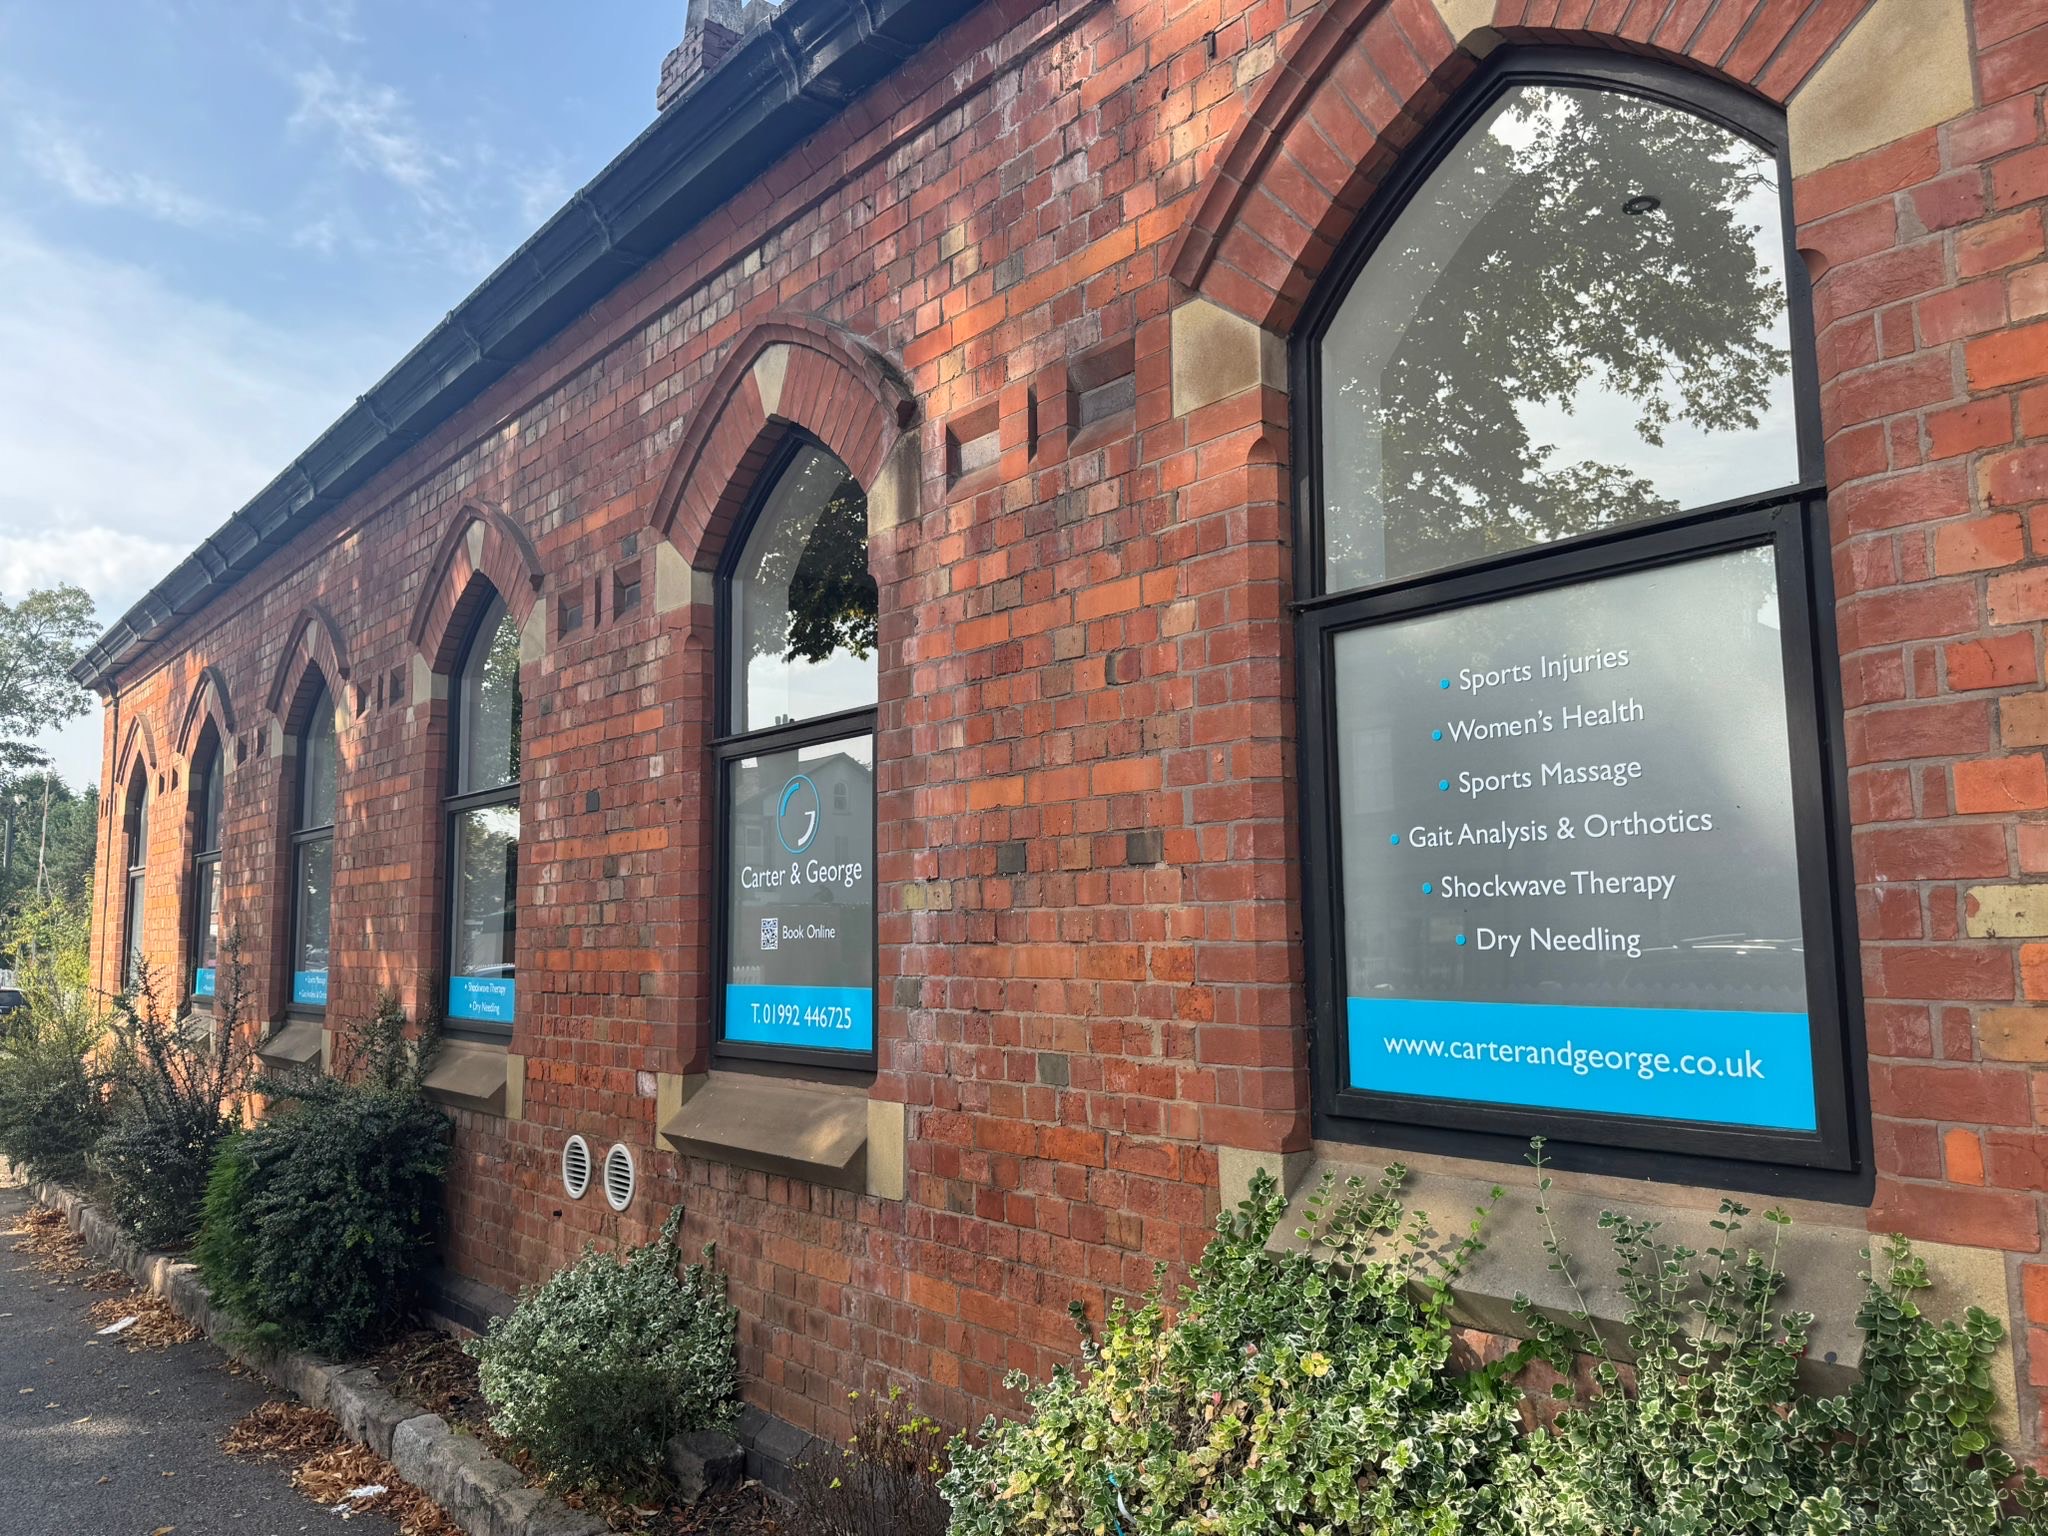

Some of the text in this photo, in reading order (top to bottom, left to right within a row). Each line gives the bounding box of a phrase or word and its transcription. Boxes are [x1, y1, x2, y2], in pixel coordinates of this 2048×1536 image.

[1458, 647, 1630, 695] Sports Injuries
[1448, 697, 1645, 743] Women's Health
[1458, 759, 1643, 799] Sports Massage
[1408, 809, 1714, 849] Gait Analysis & Orthotics
[741, 859, 862, 889] Carter & George
[1440, 871, 1677, 900] Shockwave Therapy
[782, 923, 836, 940] Book Online
[1475, 927, 1641, 958] Dry Needling
[803, 1006, 852, 1029] 446725
[1383, 1036, 1766, 1079] www.carterandgeorge.co.uk
